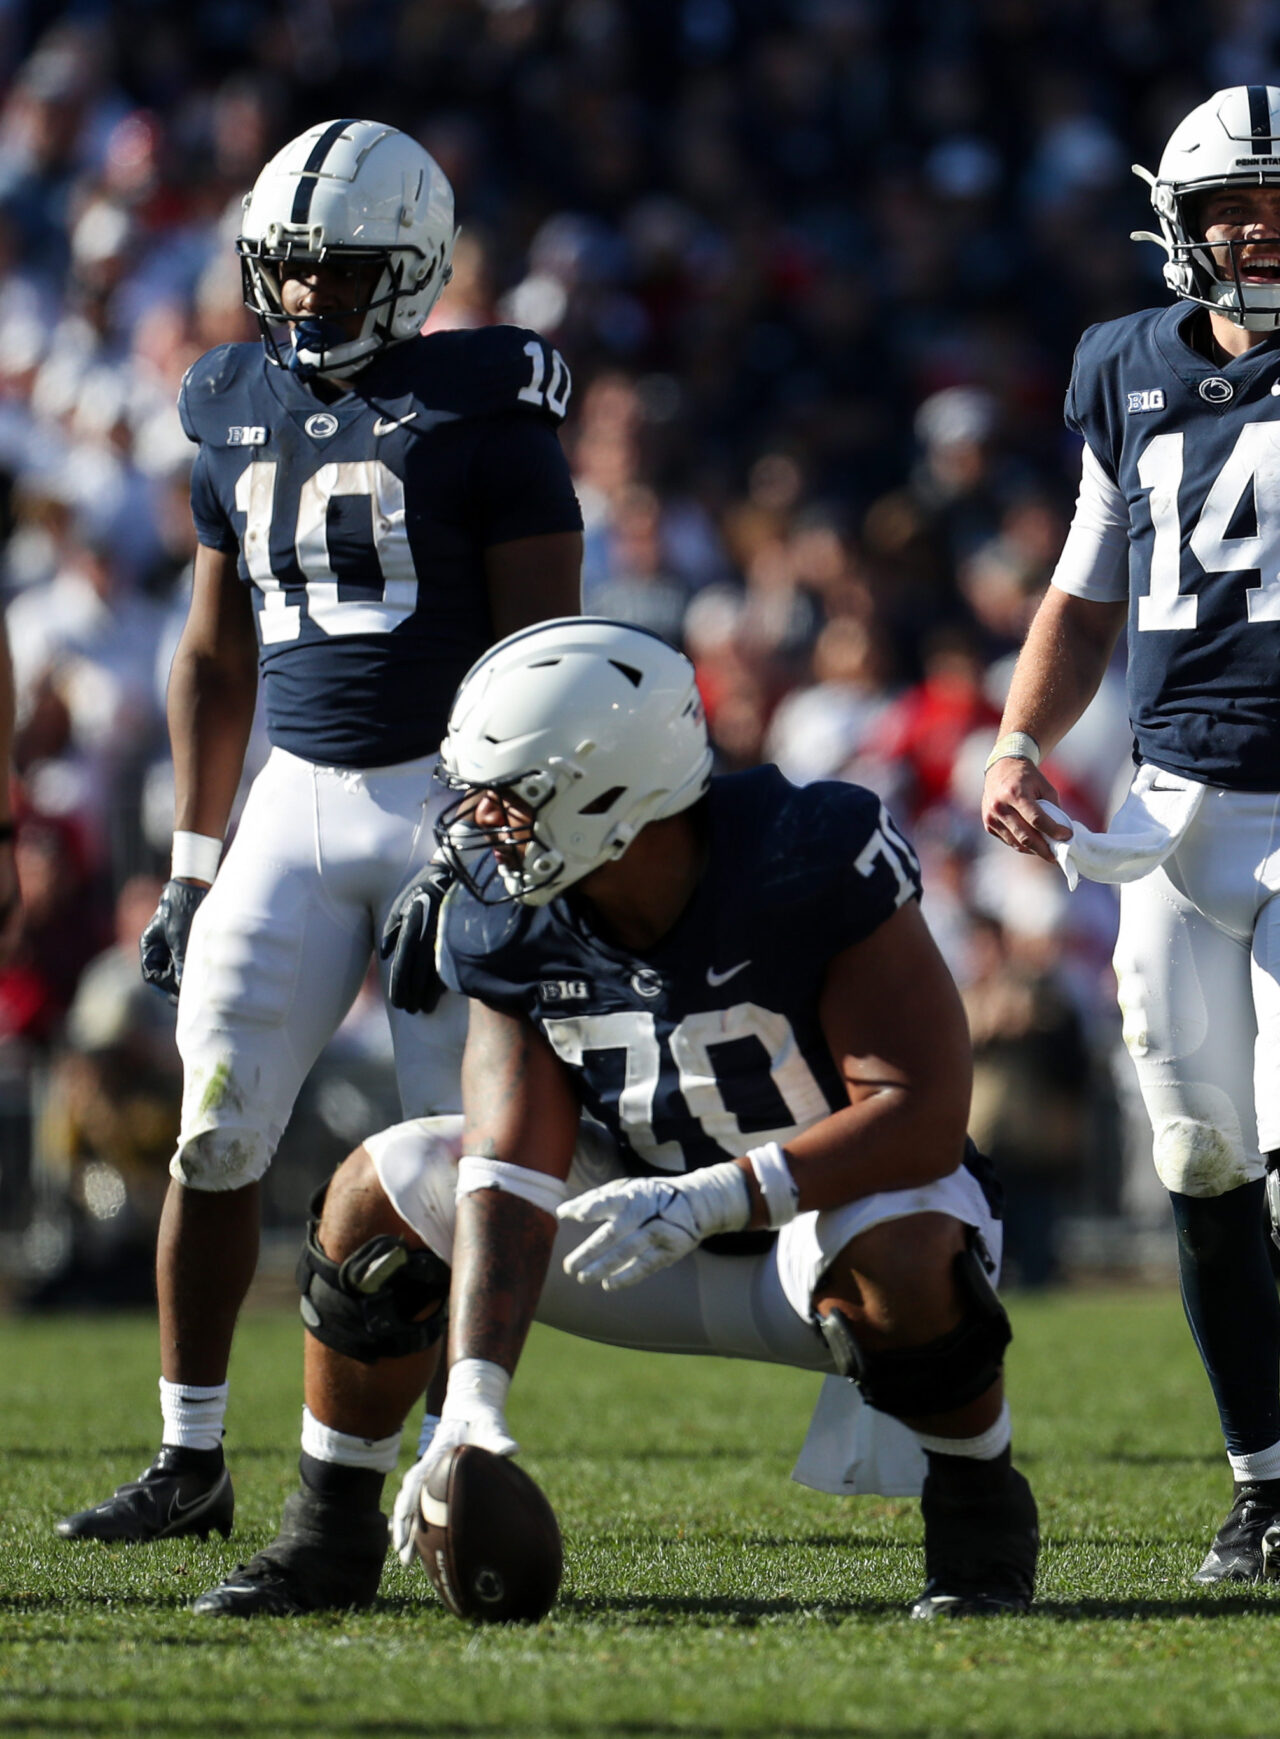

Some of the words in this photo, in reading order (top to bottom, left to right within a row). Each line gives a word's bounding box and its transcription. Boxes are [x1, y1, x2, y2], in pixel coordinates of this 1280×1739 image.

[518, 341, 571, 418] 10
[235, 460, 419, 645] 10
[541, 1002, 832, 1173] 70
